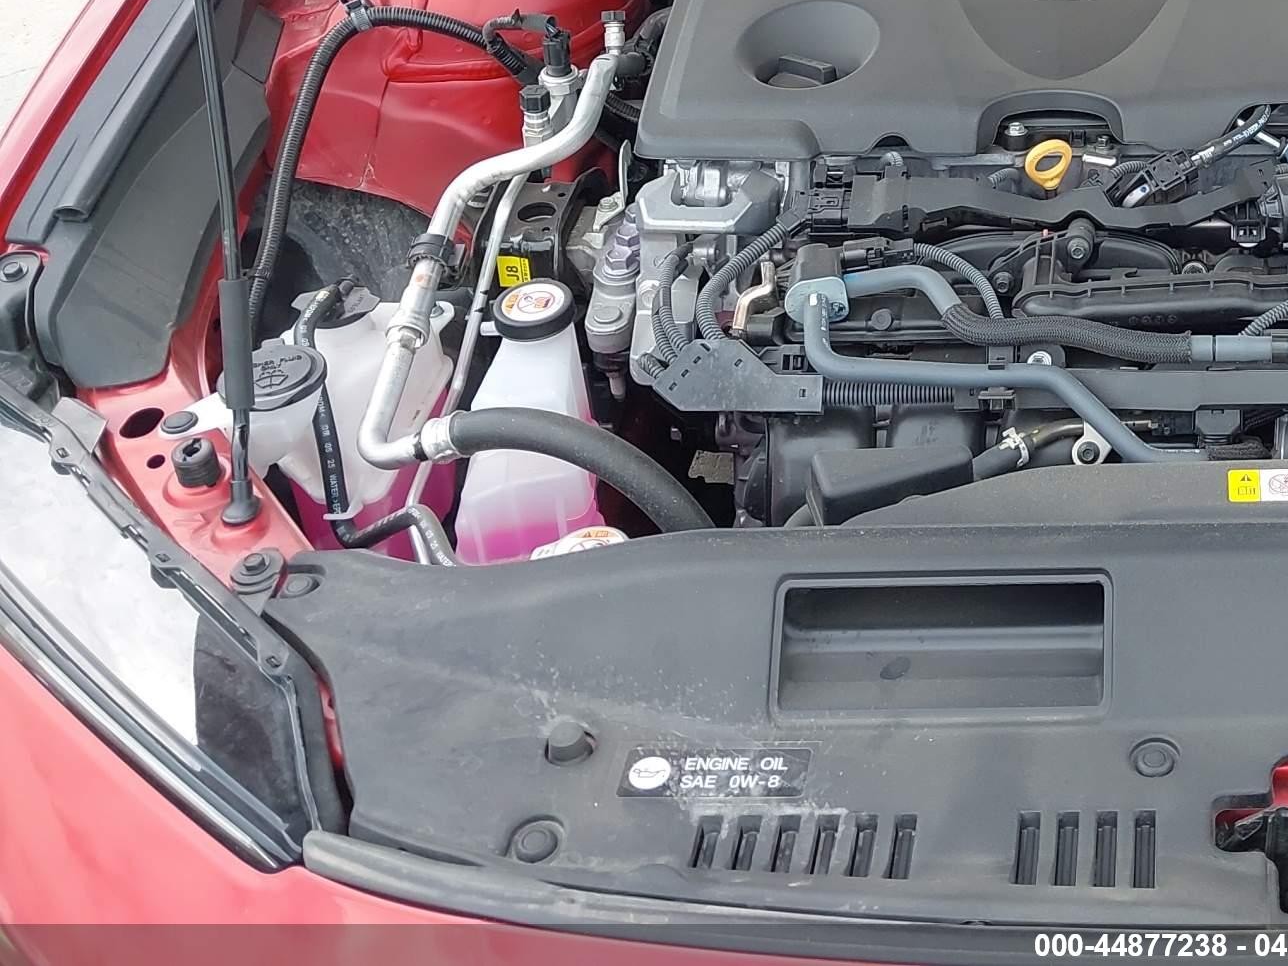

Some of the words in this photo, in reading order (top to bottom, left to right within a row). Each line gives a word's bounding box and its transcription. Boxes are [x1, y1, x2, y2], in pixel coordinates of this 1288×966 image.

[505, 265, 520, 281] J8
[329, 474, 339, 498] WATER
[684, 757, 750, 771] ENGINE
[760, 757, 788, 771] OIL
[680, 775, 716, 789] SAE
[729, 774, 781, 789] 0W-8
